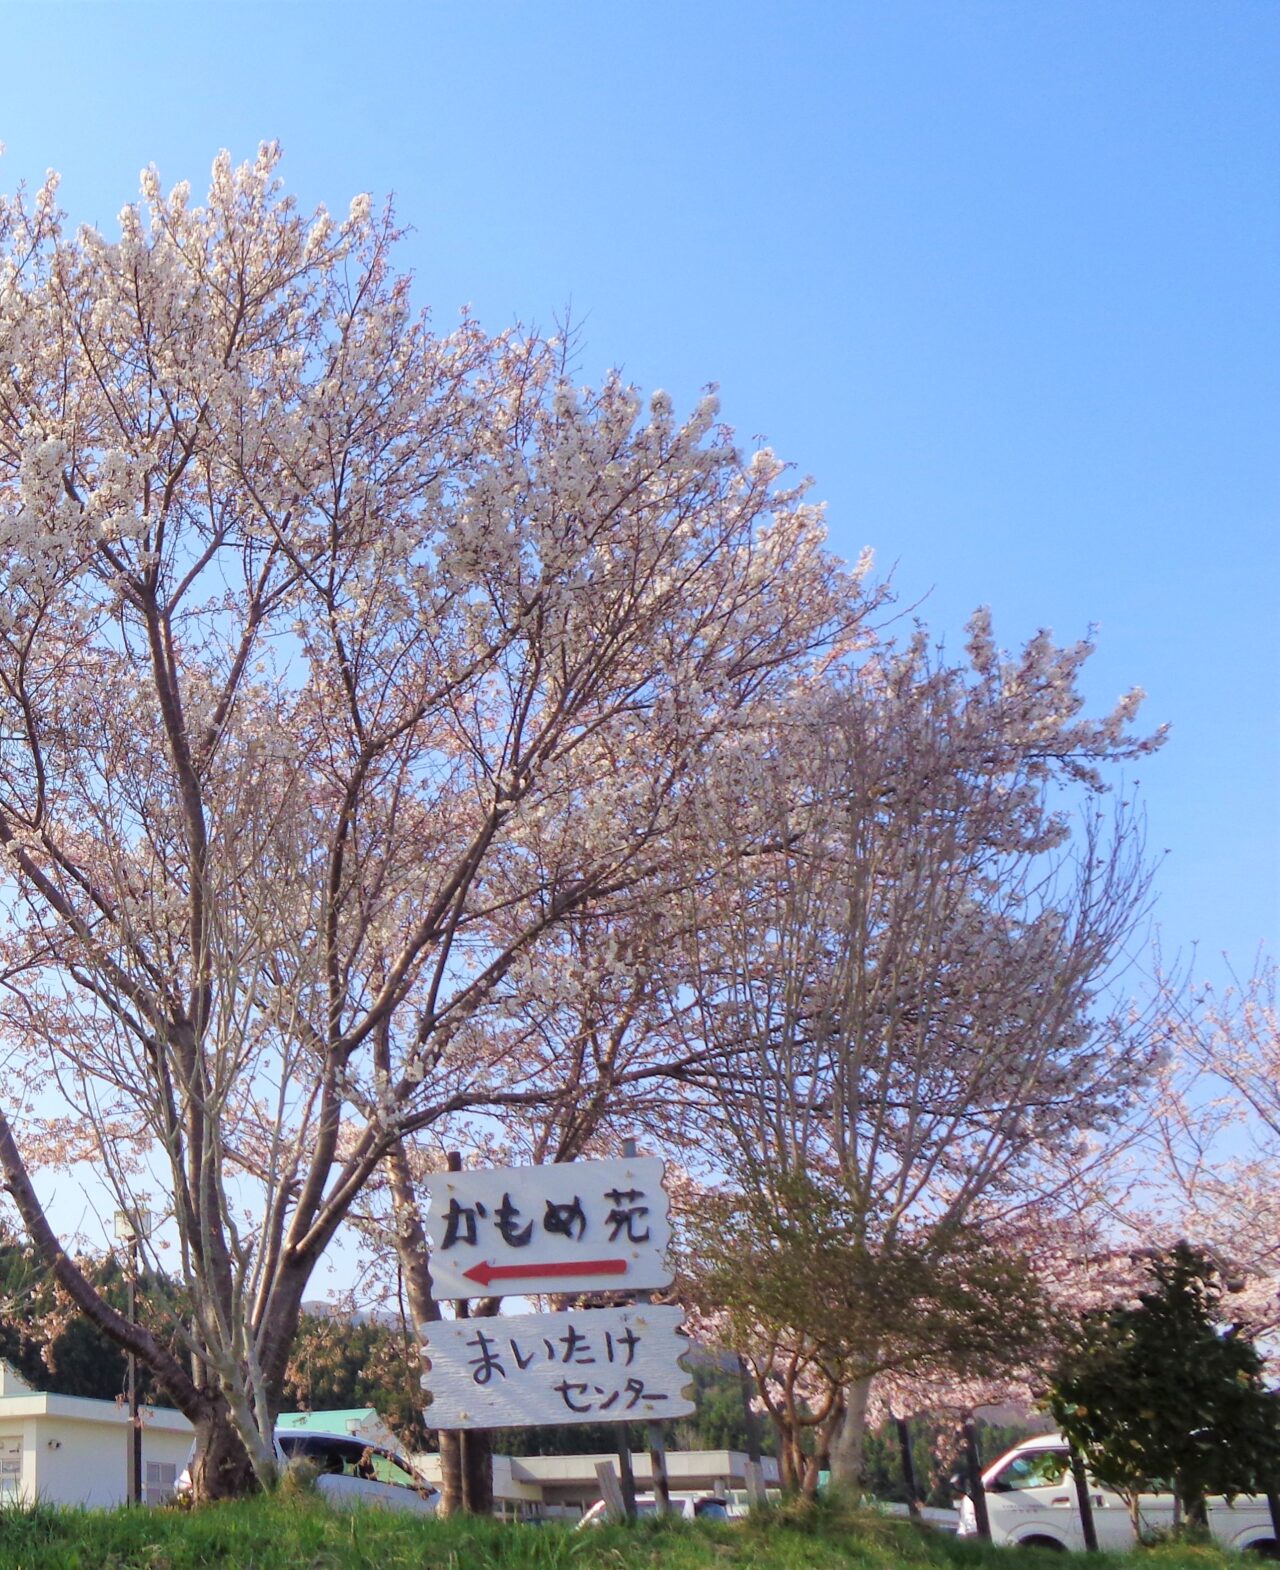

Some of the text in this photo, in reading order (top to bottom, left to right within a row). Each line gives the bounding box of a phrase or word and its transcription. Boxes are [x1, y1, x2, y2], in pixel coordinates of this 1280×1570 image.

[440, 1187, 651, 1250] かもめ苑
[465, 1324, 642, 1385] まいたけ
[553, 1376, 669, 1413] センター
